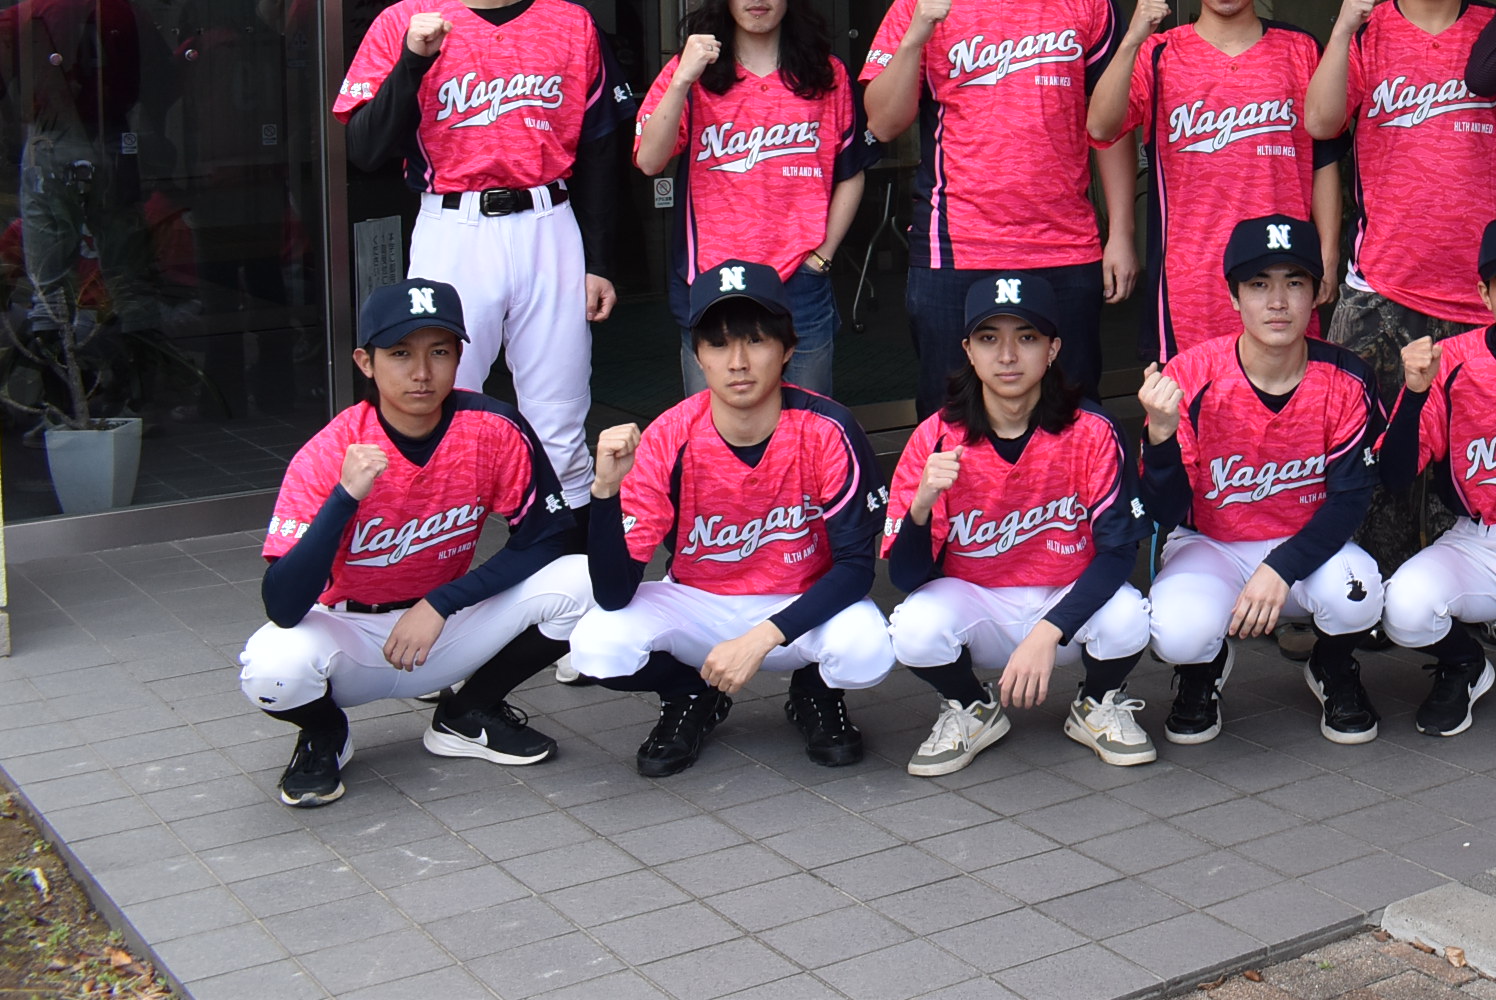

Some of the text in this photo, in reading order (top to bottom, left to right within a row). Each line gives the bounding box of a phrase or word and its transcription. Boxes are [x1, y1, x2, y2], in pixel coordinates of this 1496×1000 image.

[947, 29, 1083, 87] Nagano
[436, 71, 564, 128] Nagano
[1168, 98, 1297, 155] Nagano
[1454, 121, 1470, 132] HLTH
[1257, 145, 1272, 156] HLTH
[782, 166, 823, 178] HLTH AND ME
[1266, 224, 1292, 250] N
[719, 265, 746, 292] N
[994, 278, 1022, 304] N
[409, 287, 437, 314] N
[1205, 454, 1326, 509] Nagan
[1299, 492, 1327, 504] HLTH AN
[438, 547, 457, 560] HLTH
[457, 543, 472, 554] AND
[783, 551, 802, 564] HLTH
[1061, 544, 1075, 555] AND
